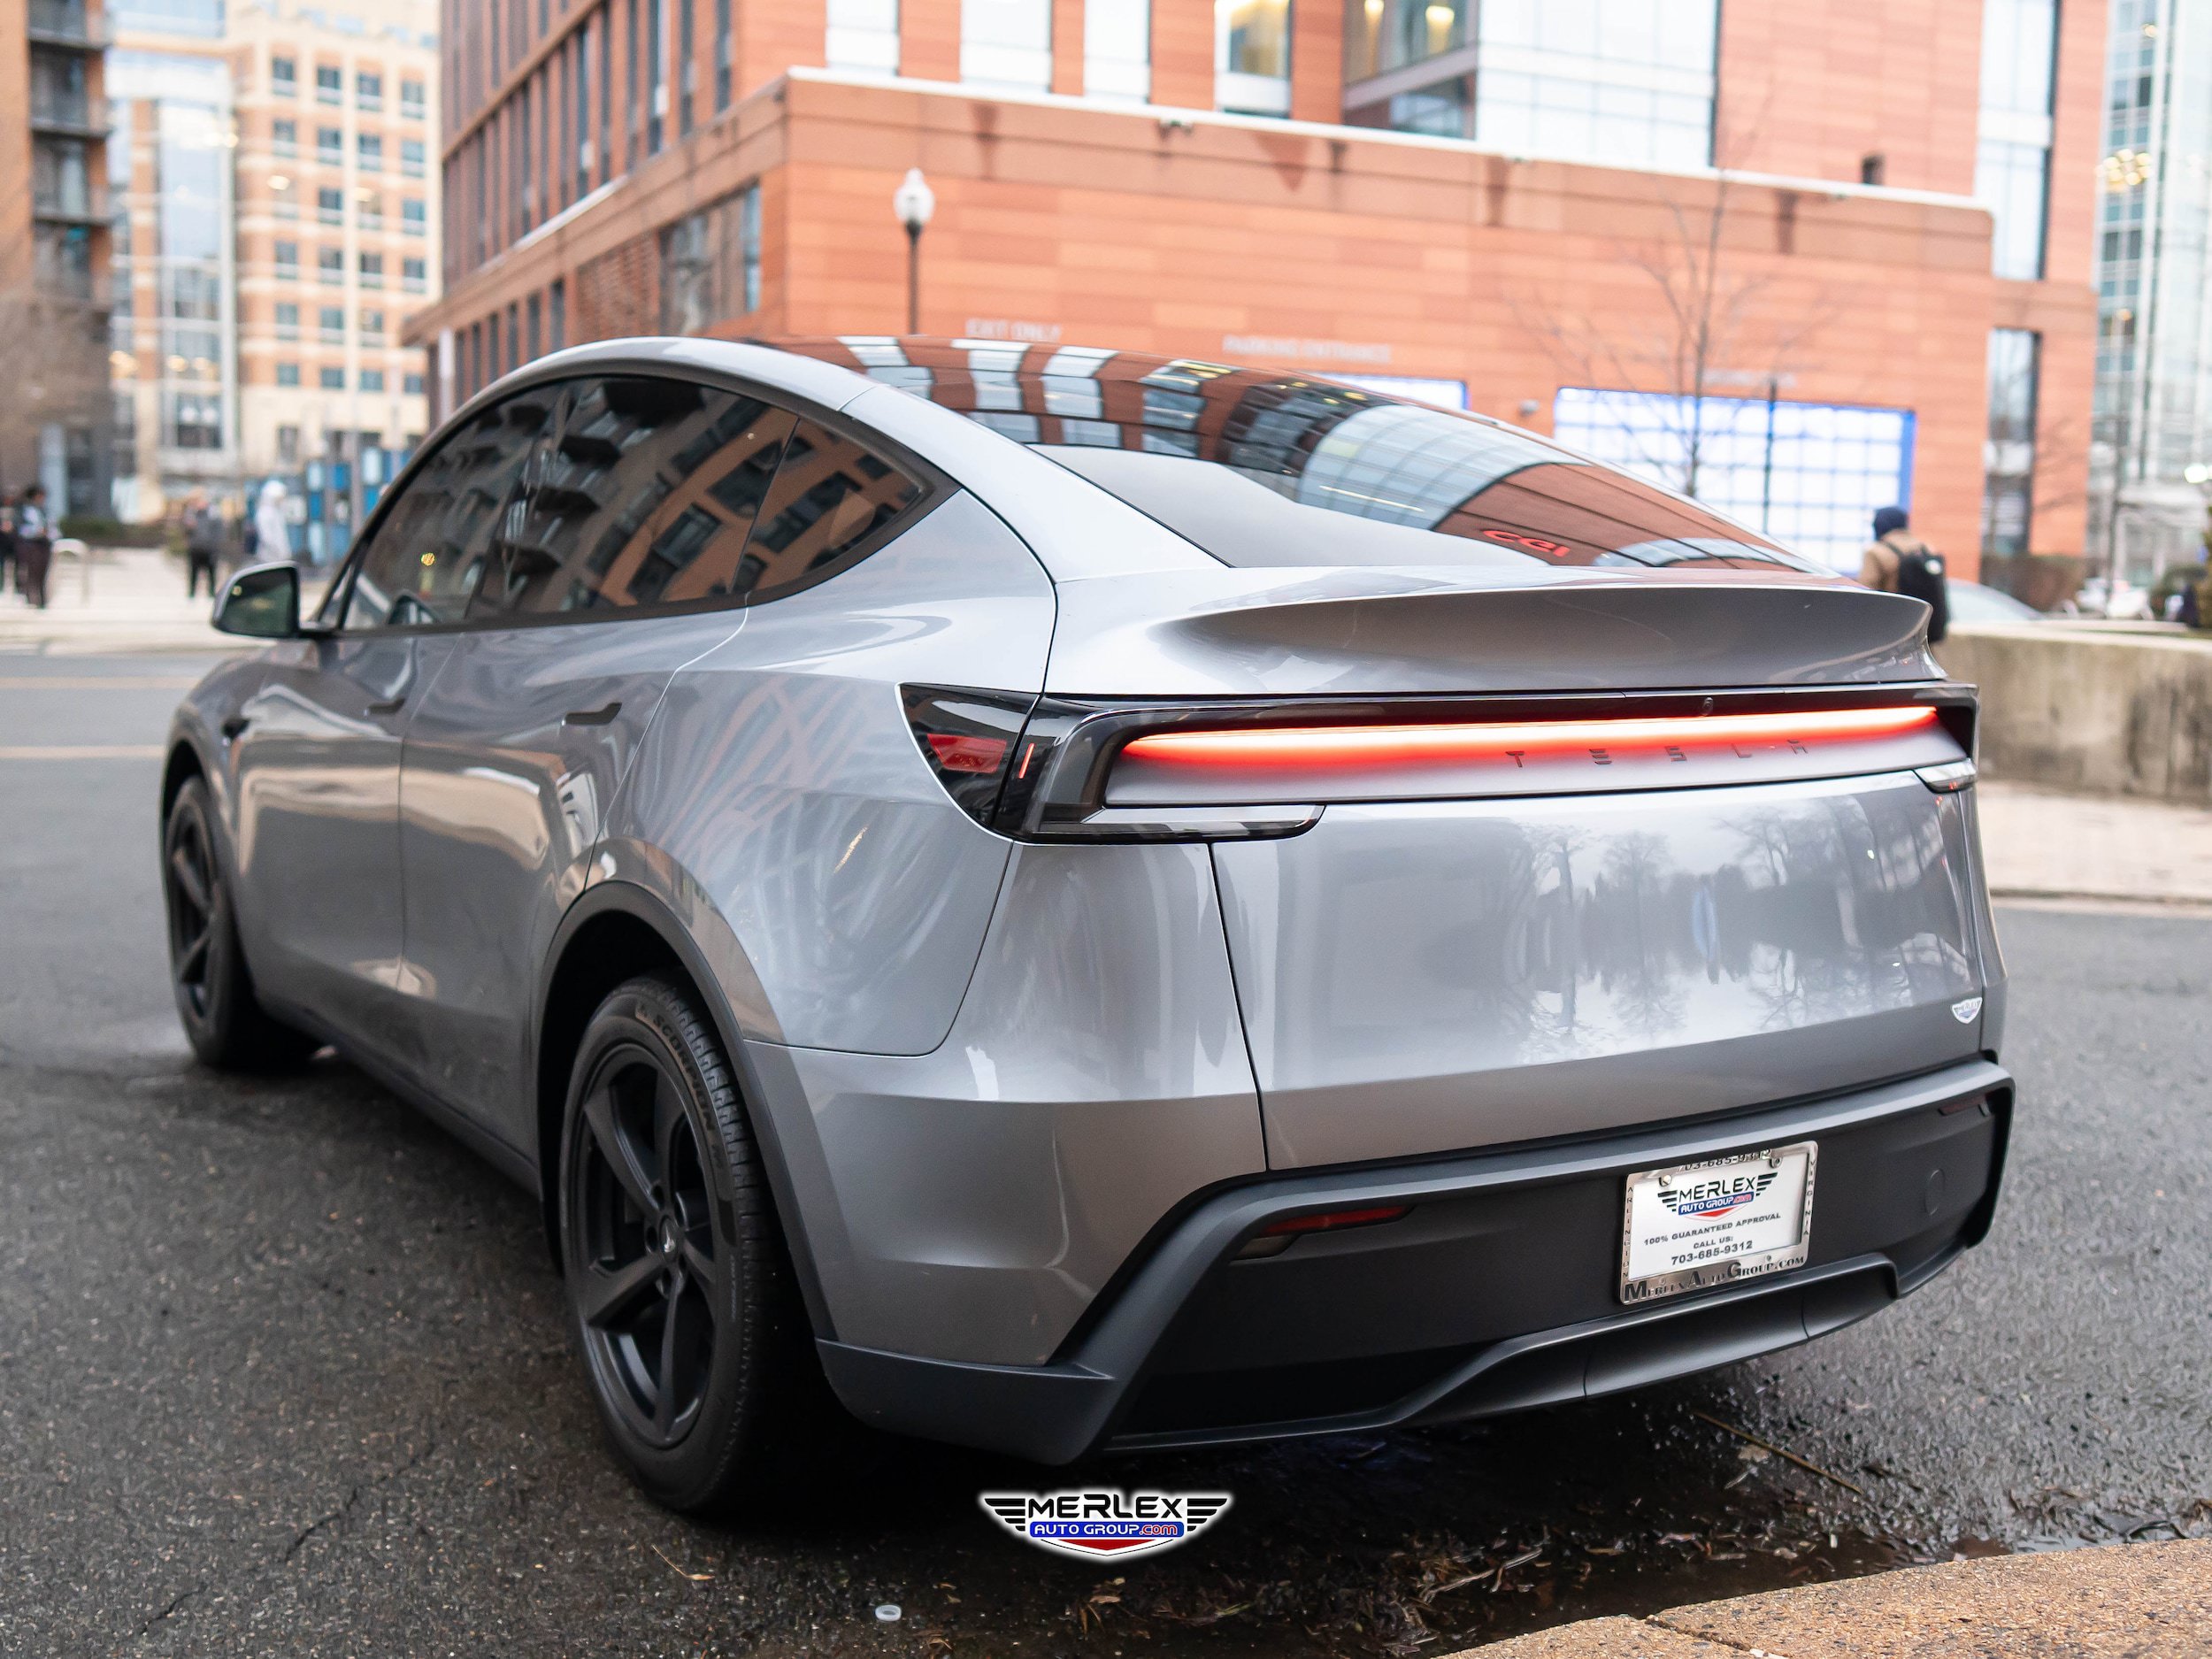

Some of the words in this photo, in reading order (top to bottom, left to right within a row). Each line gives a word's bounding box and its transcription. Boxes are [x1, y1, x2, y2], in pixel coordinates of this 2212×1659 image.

[1505, 738, 1809, 768] TESLA
[1679, 1177, 1755, 1202] MERLEX
[1803, 1160, 1816, 1235] VIRGINIA
[1681, 1202, 1705, 1213] AUTO
[1623, 1187, 1633, 1278] ARLINGTON
[1644, 1234, 1669, 1246] 100%
[1671, 1222, 1733, 1240] GUARANTEED
[1735, 1212, 1781, 1226] APPROVAL
[1671, 1240, 1754, 1265] 703-685-9312
[1694, 1238, 1717, 1249] CALL
